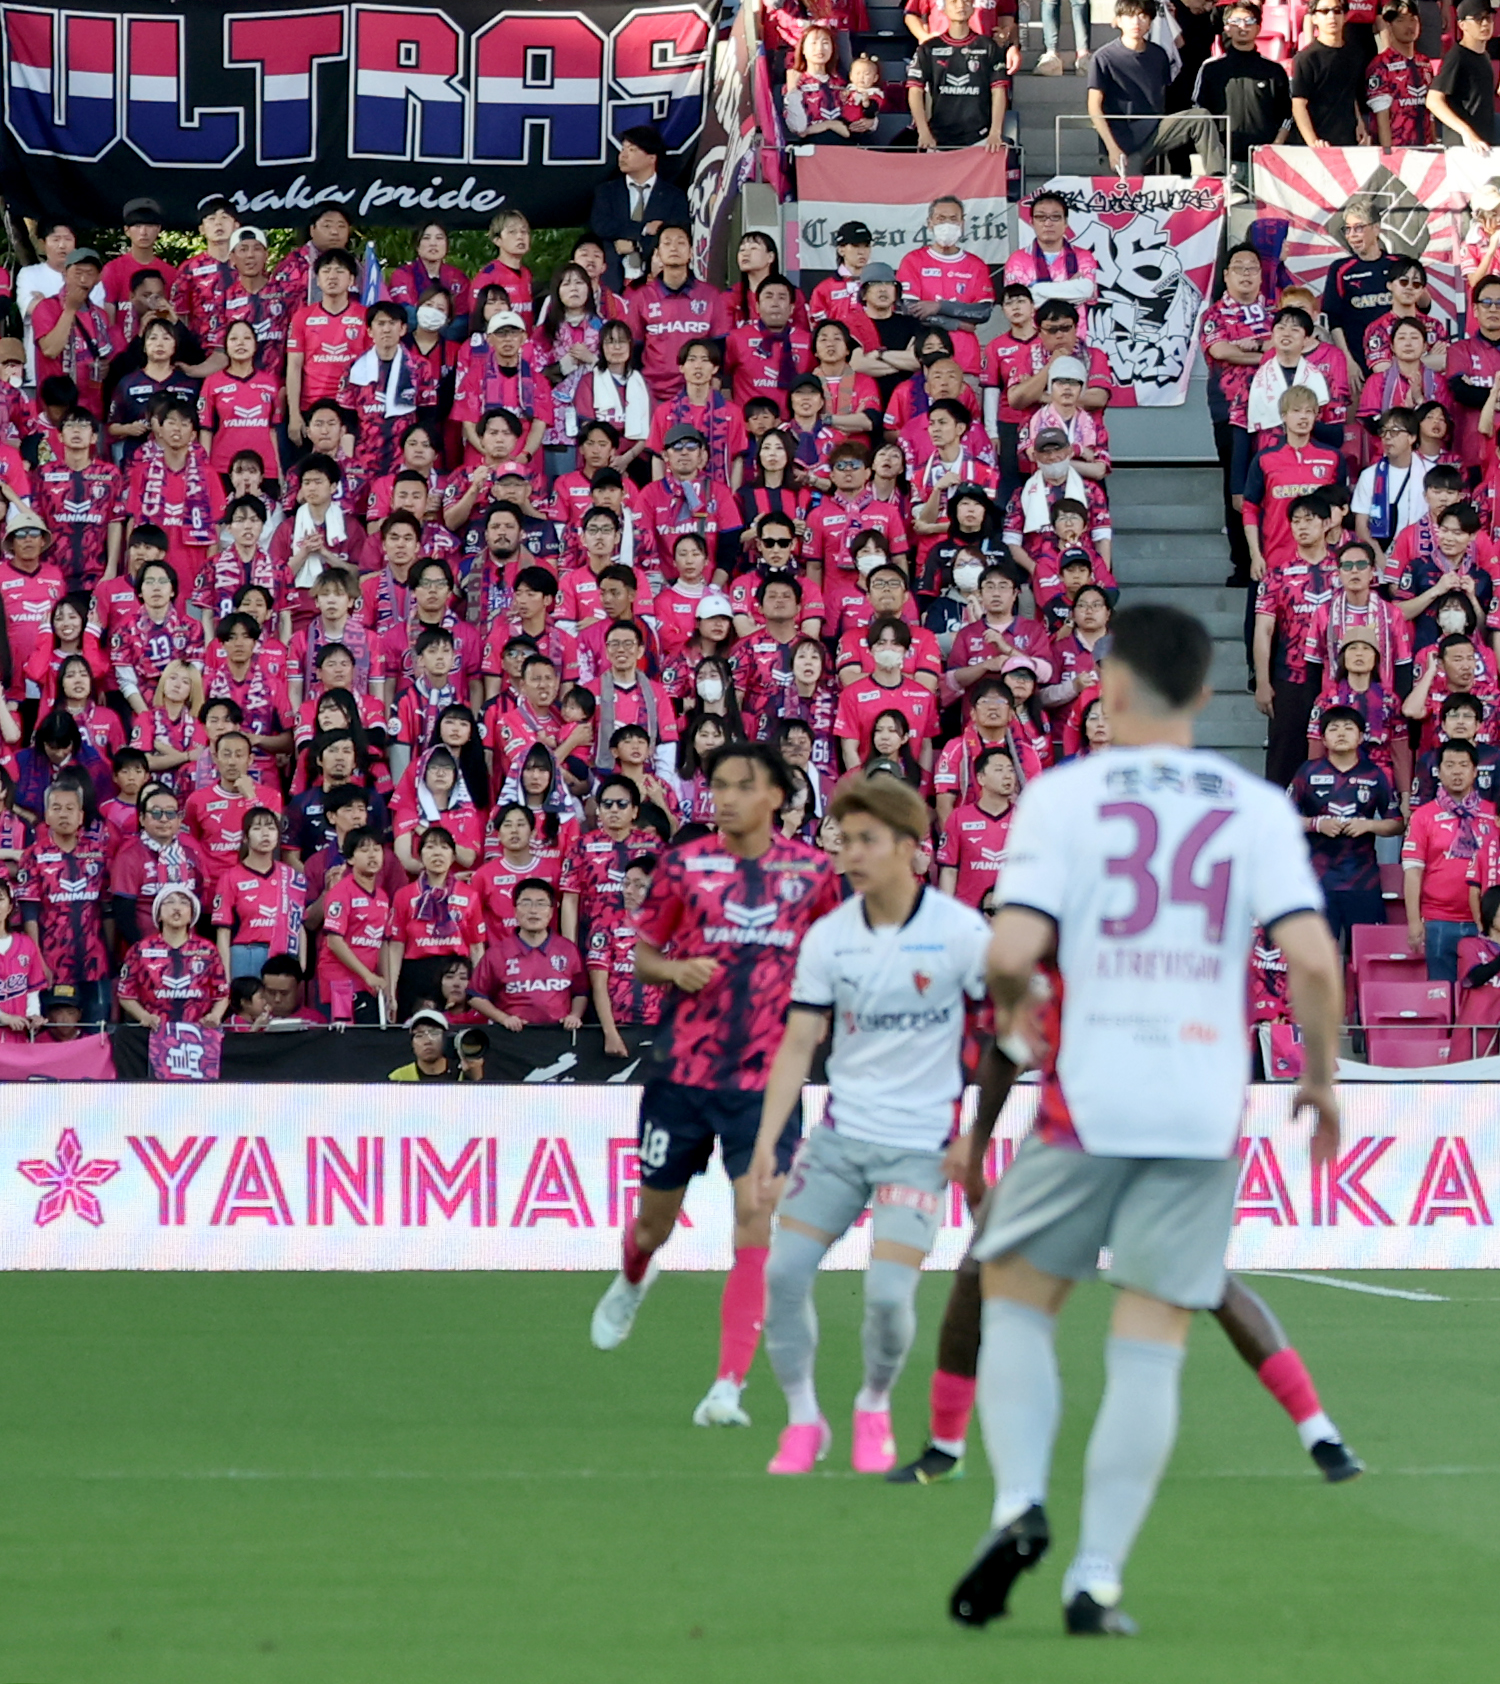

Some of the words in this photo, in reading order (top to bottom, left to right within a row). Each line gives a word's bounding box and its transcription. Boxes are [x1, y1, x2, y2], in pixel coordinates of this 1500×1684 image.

[2, 2, 714, 168] ULTRAS
[360, 174, 506, 216] pride
[1242, 306, 1263, 325] 19
[647, 321, 710, 333] SHARP
[151, 638, 173, 662] 13
[1099, 799, 1240, 945] 34
[703, 927, 796, 946] YANMAR
[507, 979, 570, 992] SHARP
